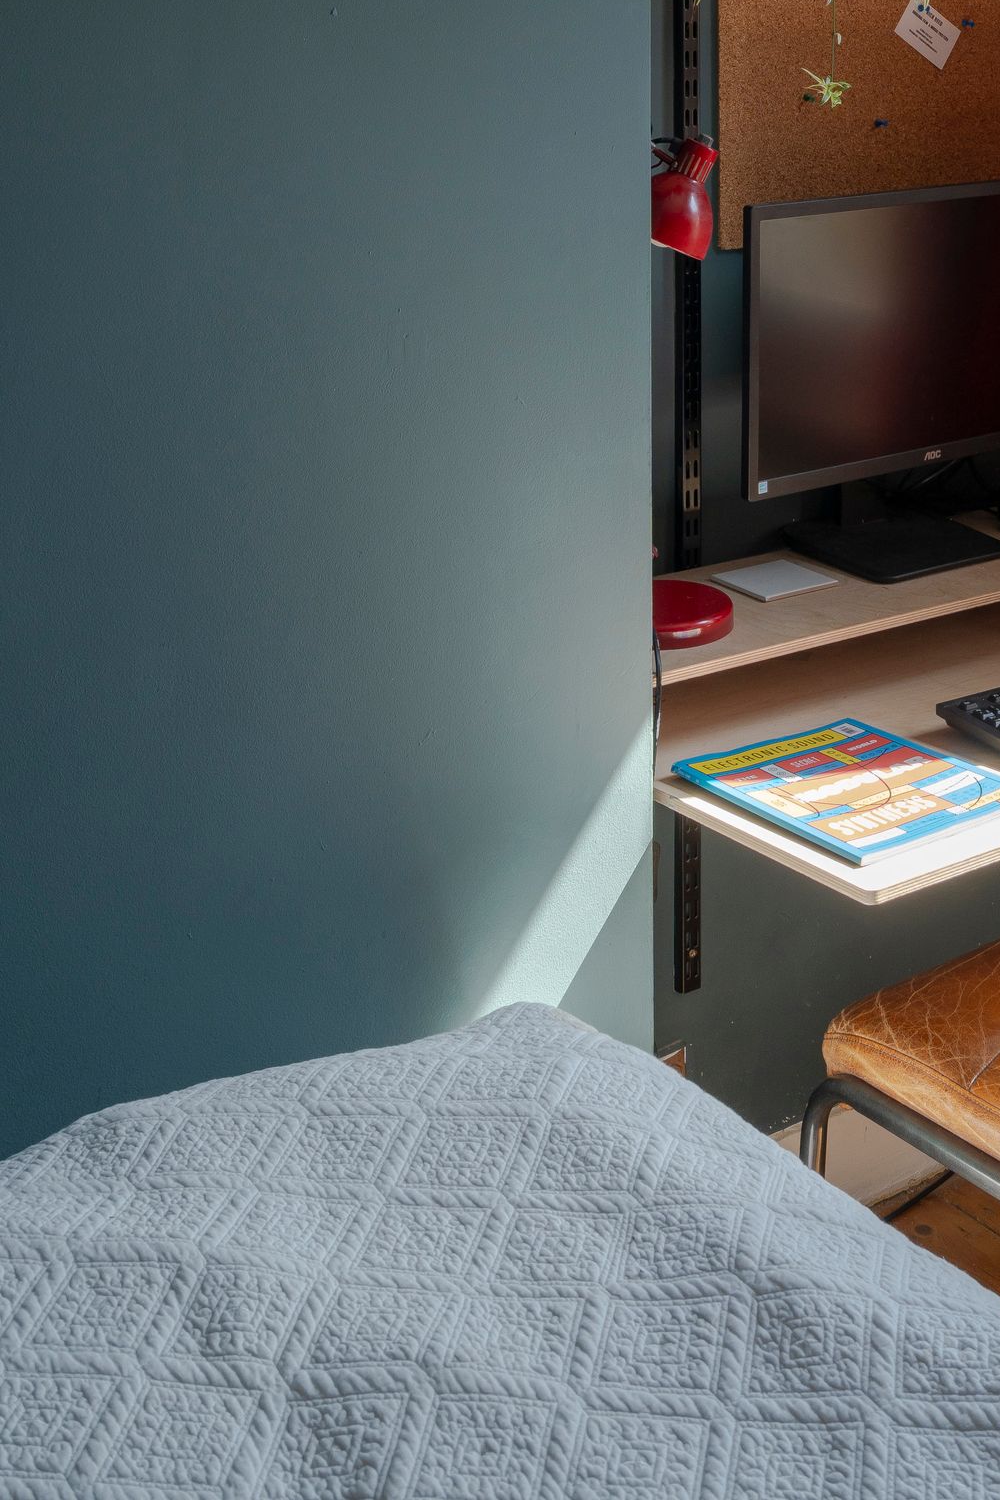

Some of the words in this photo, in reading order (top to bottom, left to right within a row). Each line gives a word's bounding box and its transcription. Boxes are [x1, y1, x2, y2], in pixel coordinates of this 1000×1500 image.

[924, 450, 942, 461] AOC
[702, 745, 789, 772] ELECTRONIC
[787, 732, 835, 750] SOUND
[828, 794, 937, 836] SYNTHESIS
